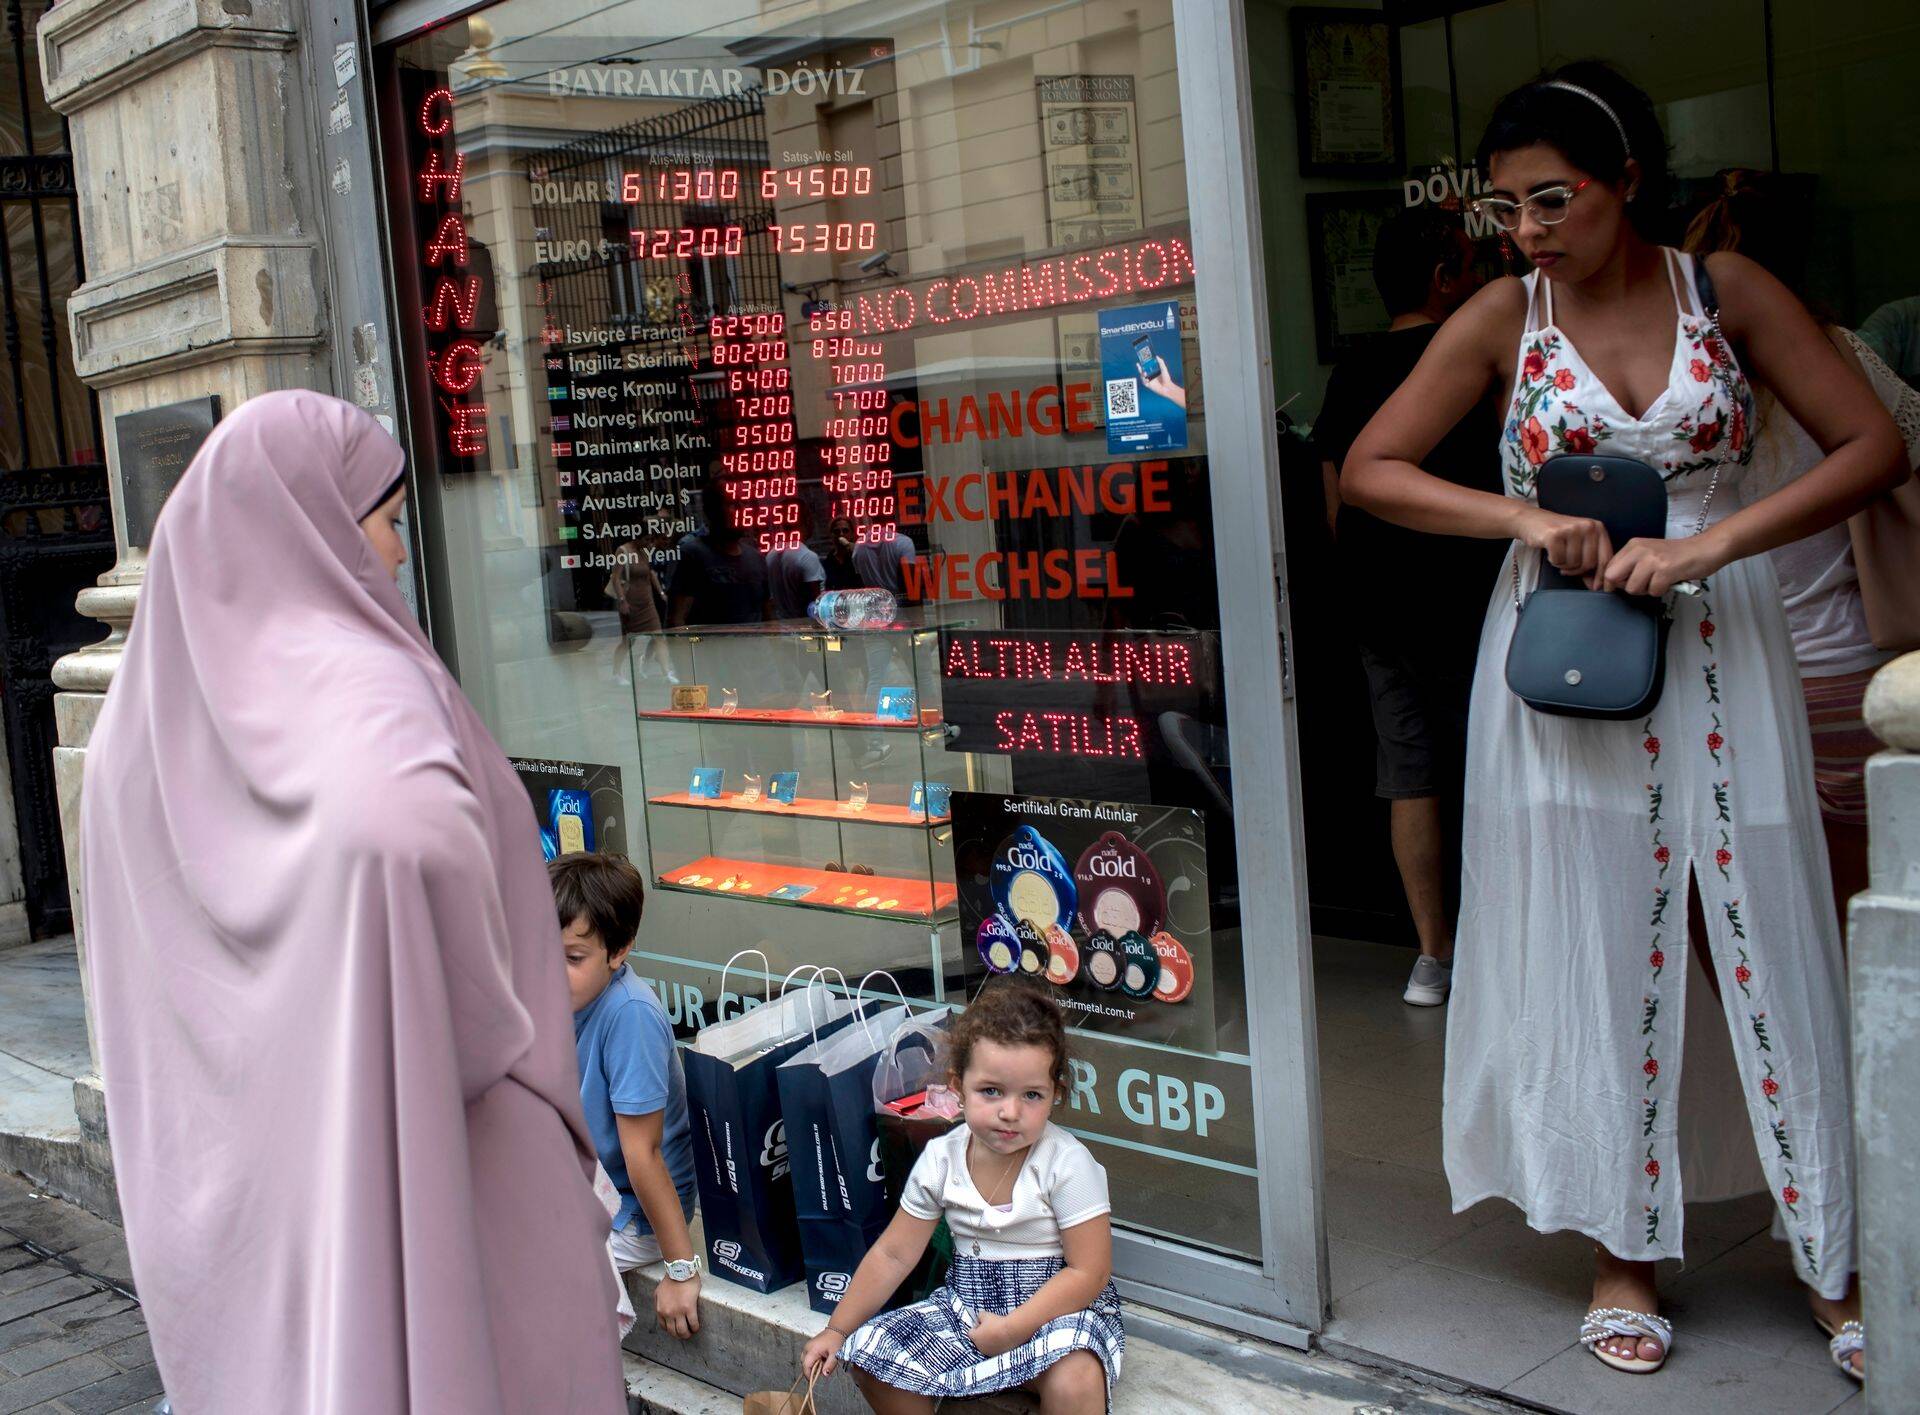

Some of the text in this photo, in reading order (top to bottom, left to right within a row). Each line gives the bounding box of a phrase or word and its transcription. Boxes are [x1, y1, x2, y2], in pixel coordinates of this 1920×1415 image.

[548, 61, 866, 97] BAYRAKTAR DÖVİZ
[1041, 79, 1130, 90] NEW DESIGNS
[694, 151, 715, 166] Buy
[816, 150, 831, 162] We
[834, 149, 853, 162] Sell
[530, 178, 617, 204] DOLAR $
[761, 167, 873, 199] 64500
[1404, 159, 1494, 208] DÖVİ
[630, 226, 742, 259] 72200
[768, 222, 876, 254] 75300
[535, 238, 610, 263] EURO €
[421, 89, 487, 454] CHANGE
[860, 238, 1197, 334] NO COMMISSION
[711, 315, 783, 337] 62500
[811, 311, 852, 332] 658
[566, 324, 625, 346] İsviçre
[569, 352, 623, 375] İngiliz
[713, 342, 785, 364] 80200
[731, 368, 789, 391] 6400
[832, 363, 885, 384] 7000
[570, 381, 677, 401] İsveç Kronu
[833, 390, 886, 411] 7700
[736, 395, 790, 417] 7200
[889, 382, 1096, 449] CHANGE
[573, 408, 695, 429] Norveç Kronu
[825, 416, 888, 438] 10000
[575, 435, 711, 457] Danimarka Krn.
[736, 423, 793, 446] 9500
[723, 450, 795, 472] 46000
[820, 443, 890, 465] 49800
[577, 463, 701, 486] Kanada Doları
[823, 469, 892, 493] 46500
[581, 488, 691, 512] Avustralya $
[725, 477, 797, 500] 43000
[896, 460, 1172, 526] EXCHANGE
[734, 504, 799, 528] 16250
[832, 496, 895, 519] 17000
[582, 516, 696, 542] S.Arap Riyali
[856, 522, 896, 544] 580
[759, 530, 801, 552] 500
[584, 546, 682, 571] Japon Yeni
[901, 549, 1135, 602] WECHSEL
[947, 640, 1191, 684] ALTIN ALINIR
[996, 712, 1143, 758] SATILIR
[509, 761, 539, 772] ertifikalı
[540, 763, 559, 774] Gram
[558, 799, 580, 813] Gold
[1004, 800, 1138, 823] Sertifikalı Gram Altınlar
[1019, 842, 1034, 850] nadir
[1101, 849, 1117, 857] nadir
[1007, 847, 1052, 872] Gold
[1090, 855, 1136, 878] Gold
[987, 924, 1009, 937] Gold
[1016, 927, 1037, 940] Gold
[1045, 932, 1067, 945] Gold
[1091, 939, 1114, 951] Gold
[640, 976, 706, 1029] UR
[1056, 998, 1135, 1019] nadirmetal.com.tr
[1117, 1067, 1226, 1137] GBP
[719, 1257, 764, 1281] SKECHERS
[823, 1292, 843, 1302] SKE
